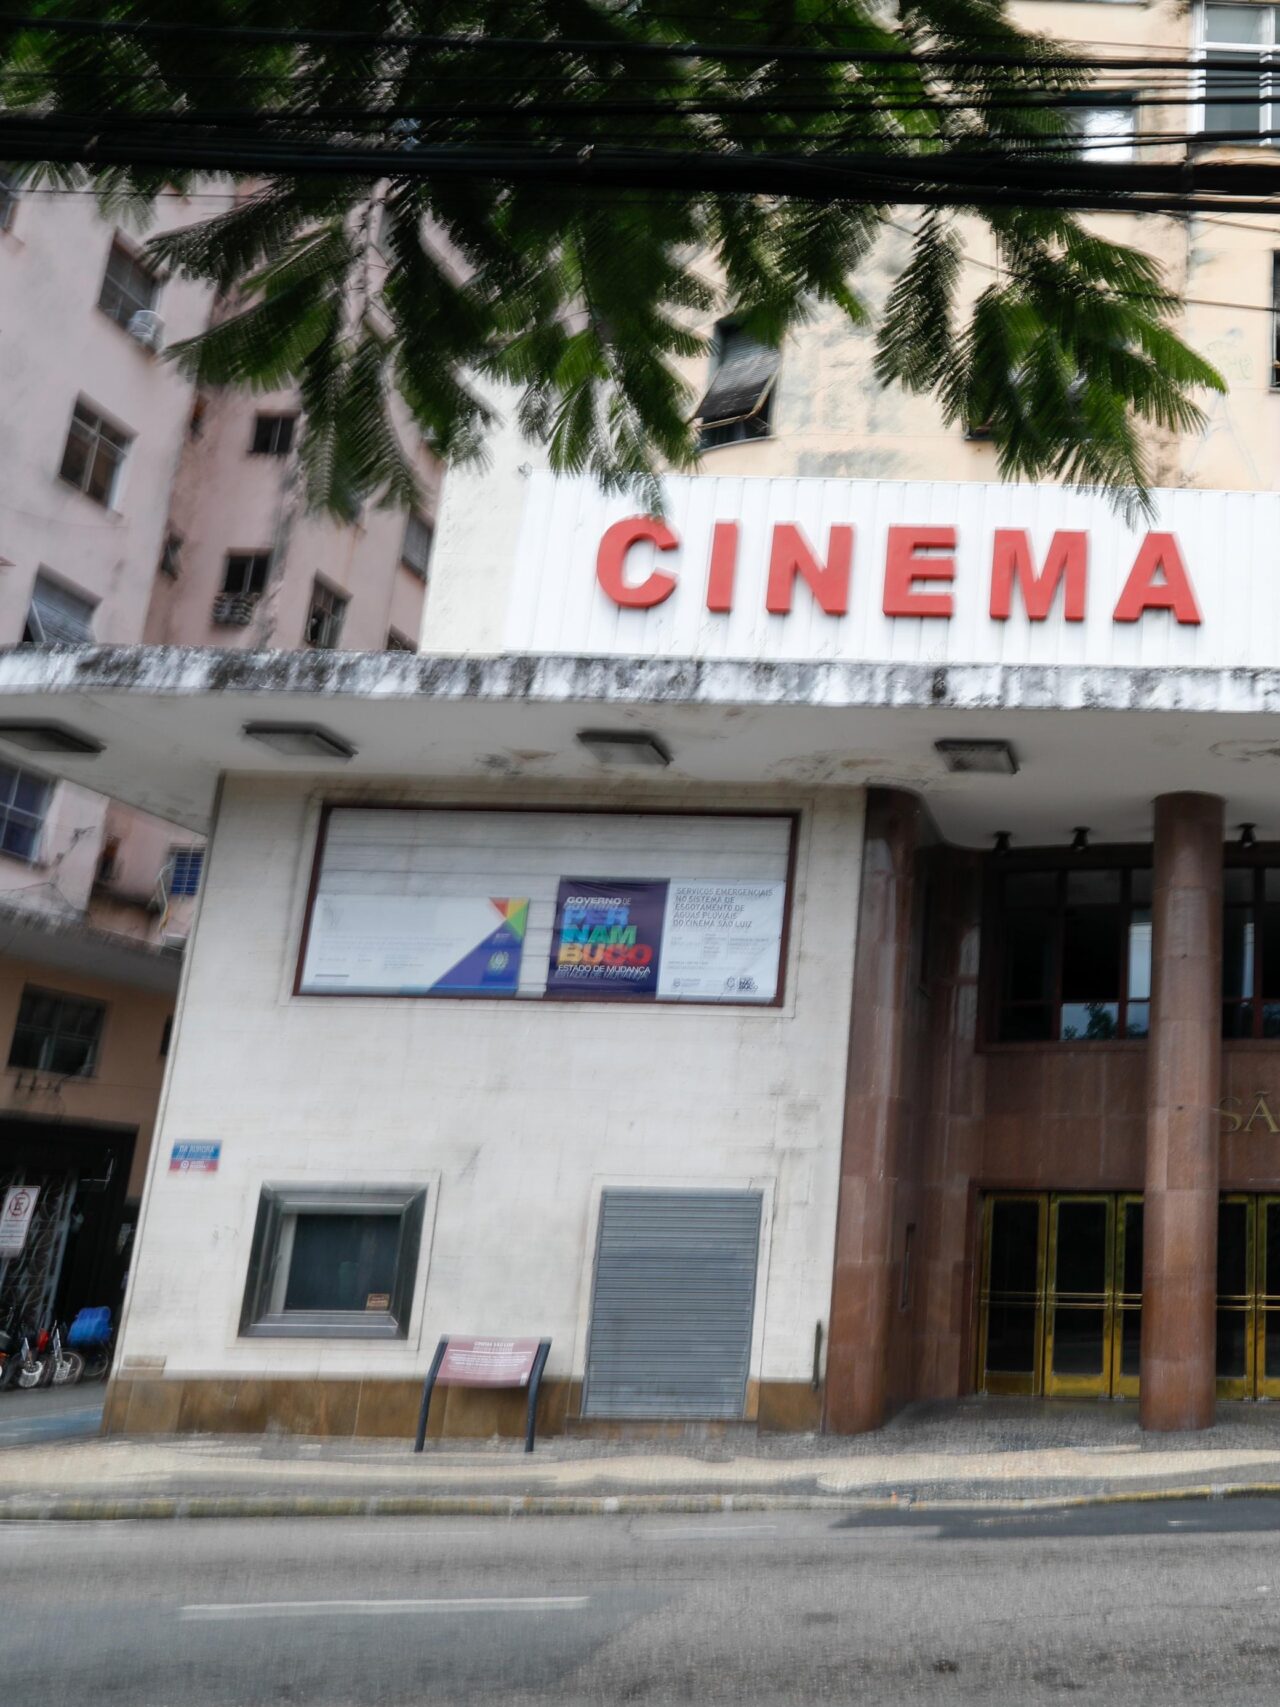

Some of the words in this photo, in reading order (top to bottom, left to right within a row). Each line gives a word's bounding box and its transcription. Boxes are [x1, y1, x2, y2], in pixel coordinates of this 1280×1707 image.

[596, 513, 1203, 624] CINEMA
[565, 896, 622, 905] GOVERNO
[622, 897, 632, 905] DE
[563, 906, 630, 926] PER
[686, 920, 715, 928] CINEMA
[735, 920, 753, 929] LUIZ
[561, 924, 638, 944] NAM
[557, 942, 653, 964] BUCO
[558, 964, 592, 973] ESTADO
[593, 965, 606, 973] DE
[606, 965, 651, 975] MUDANÇA
